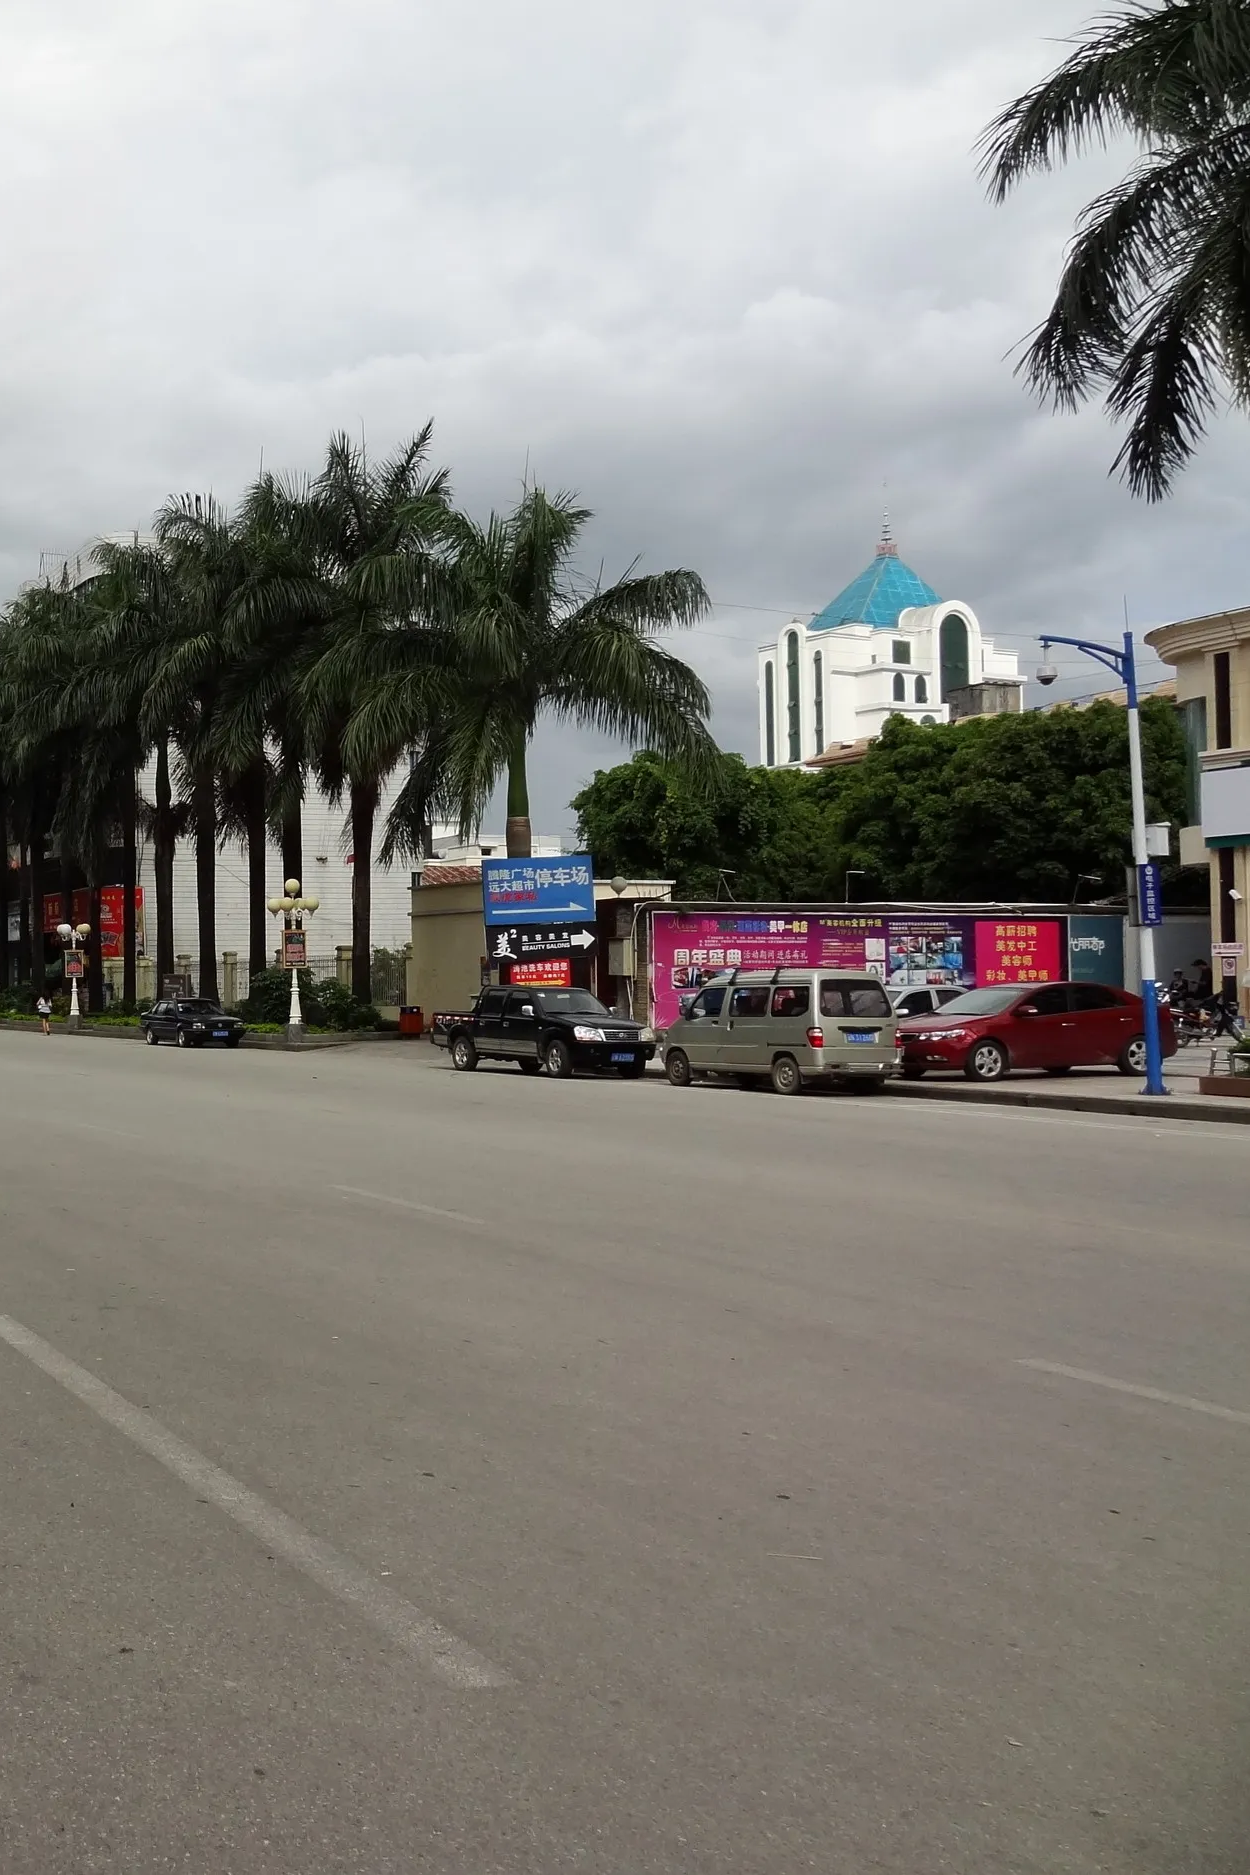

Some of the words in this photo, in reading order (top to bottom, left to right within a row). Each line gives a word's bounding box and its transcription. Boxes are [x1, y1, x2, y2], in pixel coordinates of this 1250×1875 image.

[535, 866, 589, 888] 停车场
[488, 880, 534, 893] 远大超市
[995, 925, 1037, 937] 高薪招聘
[522, 944, 545, 952] BEAUTY
[546, 942, 570, 950] SALONS
[995, 940, 1037, 952] 美发中工
[674, 949, 742, 966] 周年盛典
[1001, 955, 1033, 967] 美容师
